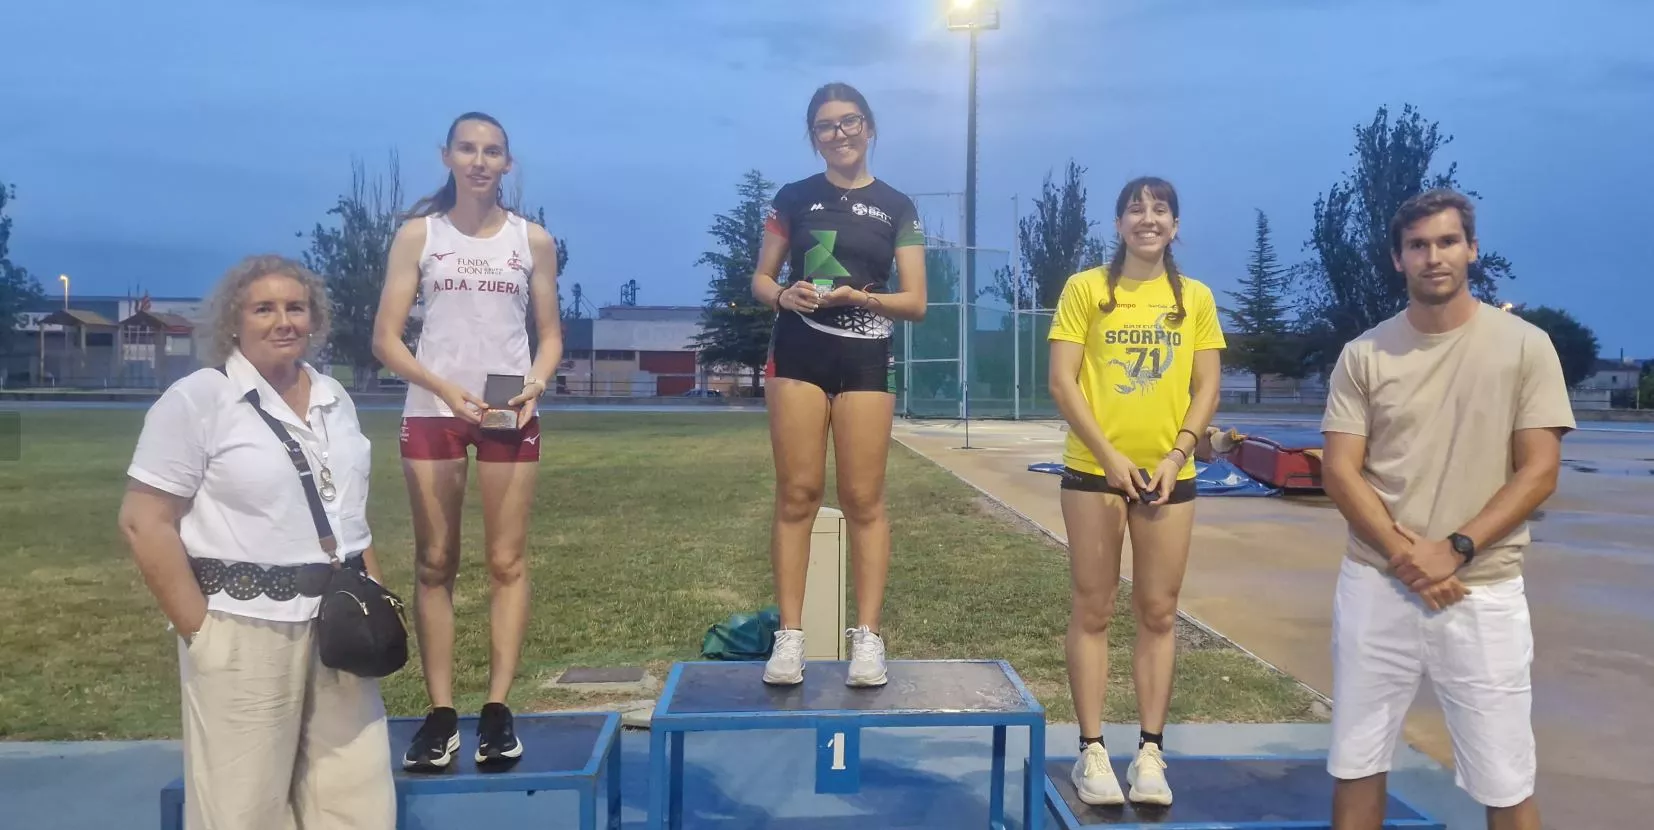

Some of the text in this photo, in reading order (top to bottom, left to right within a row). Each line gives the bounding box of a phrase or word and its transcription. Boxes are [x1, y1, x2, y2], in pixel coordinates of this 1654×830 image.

[433, 278, 520, 296] A.D.A. ZUERA
[1105, 329, 1182, 347] SCORPIO
[1125, 347, 1162, 379] 71
[827, 732, 847, 770] 1
